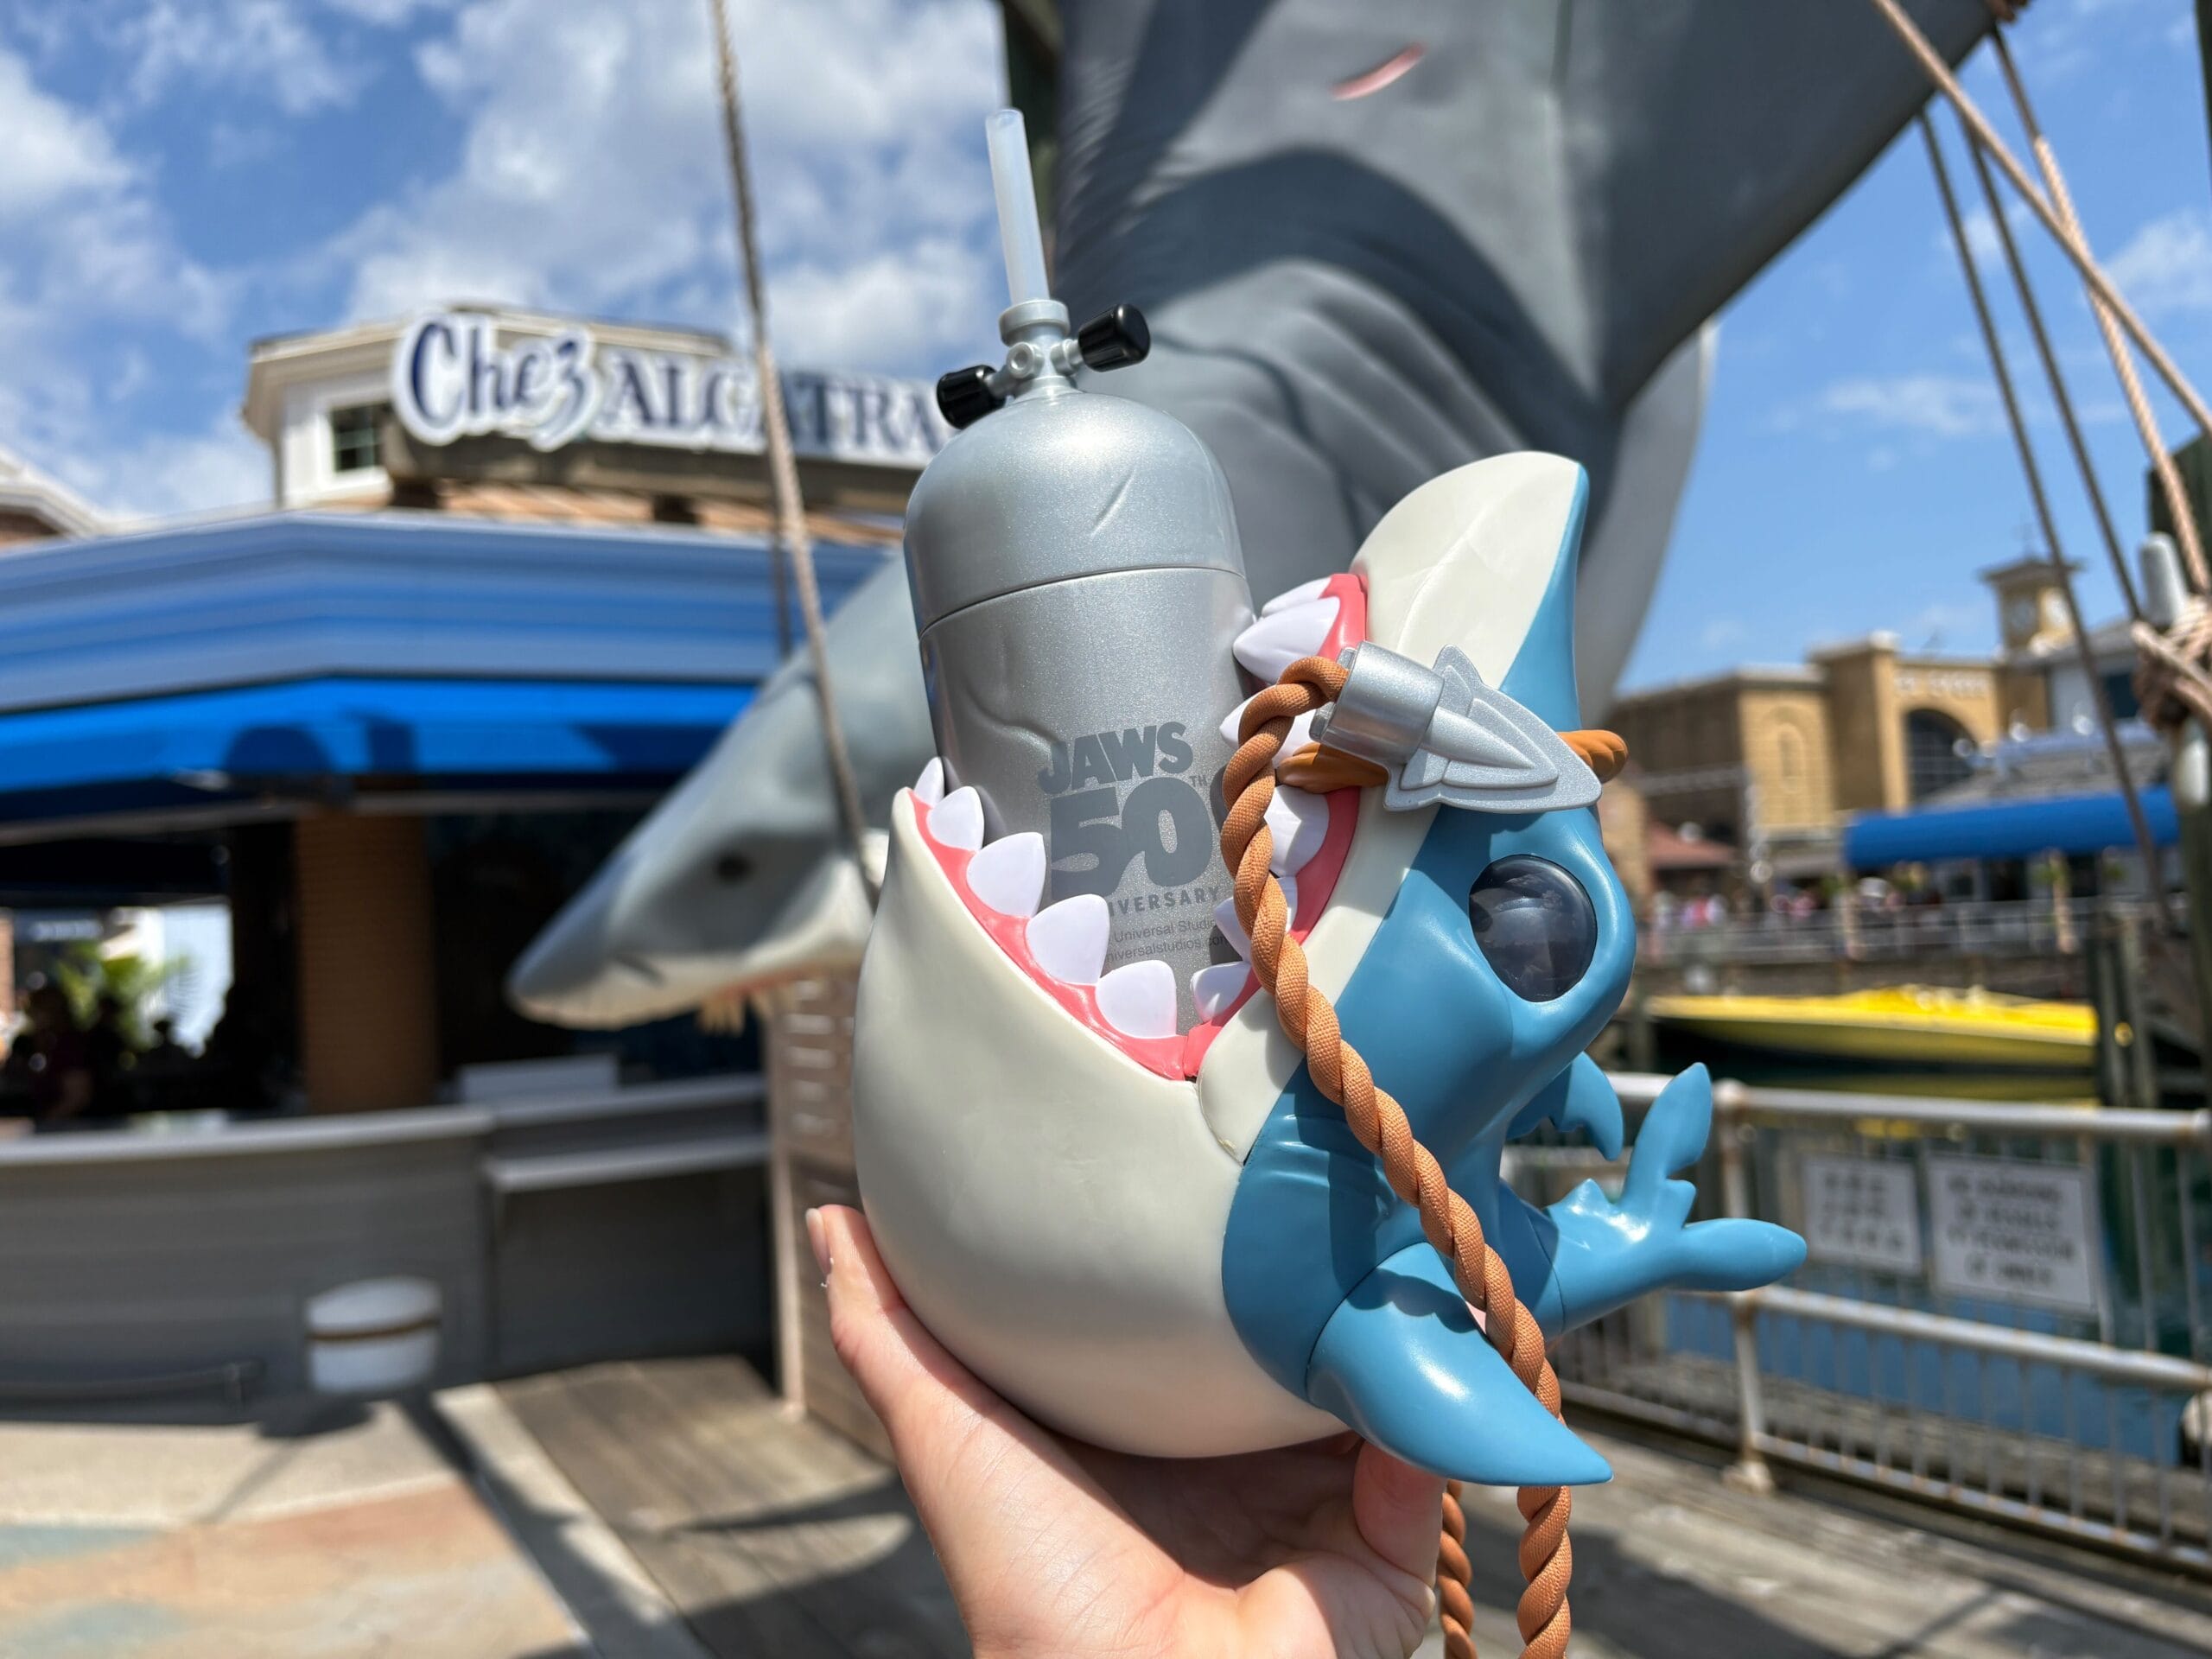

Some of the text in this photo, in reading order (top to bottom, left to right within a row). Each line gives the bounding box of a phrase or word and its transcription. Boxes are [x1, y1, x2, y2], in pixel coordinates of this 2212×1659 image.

[404, 316, 944, 454] Chez ALCATRA
[1038, 721, 1194, 794] JAWS
[1050, 778, 1211, 901] 50
[1108, 887, 1219, 917] IVERSARY
[1114, 921, 1175, 944] Universal
